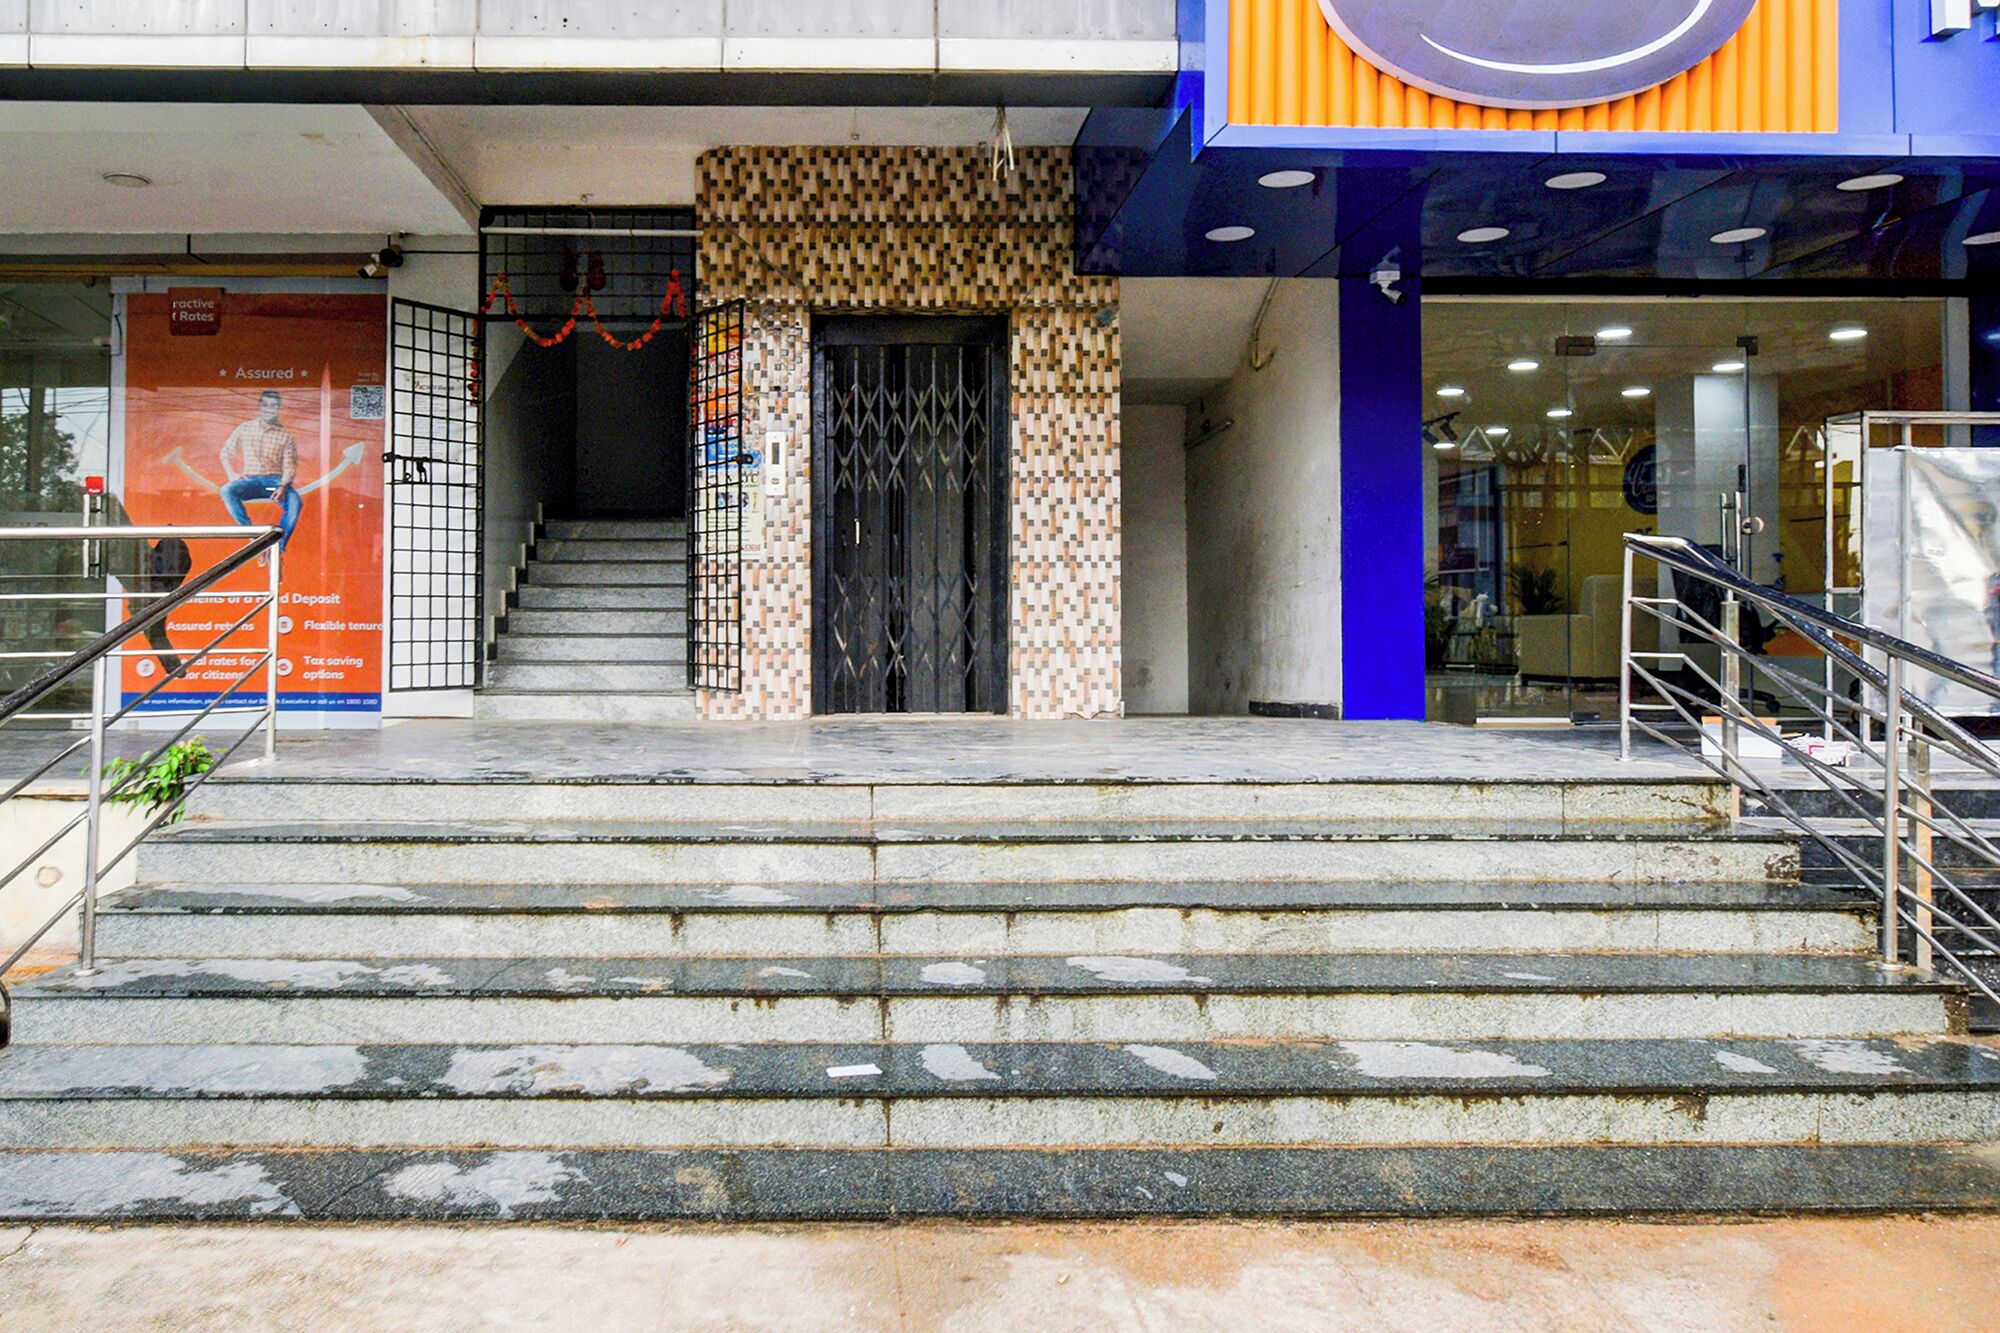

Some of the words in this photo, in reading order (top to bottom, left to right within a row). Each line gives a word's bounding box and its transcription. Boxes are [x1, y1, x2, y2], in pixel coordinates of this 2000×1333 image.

[180, 311, 214, 322] Rates
[235, 367, 294, 379] Assured
[292, 593, 341, 606] Deposit
[166, 621, 212, 631] Assured
[304, 620, 346, 630] Flexible
[208, 656, 238, 666] rates
[239, 656, 257, 666] for
[303, 656, 325, 666] Tax
[327, 656, 364, 668] saving
[303, 669, 345, 681] options
